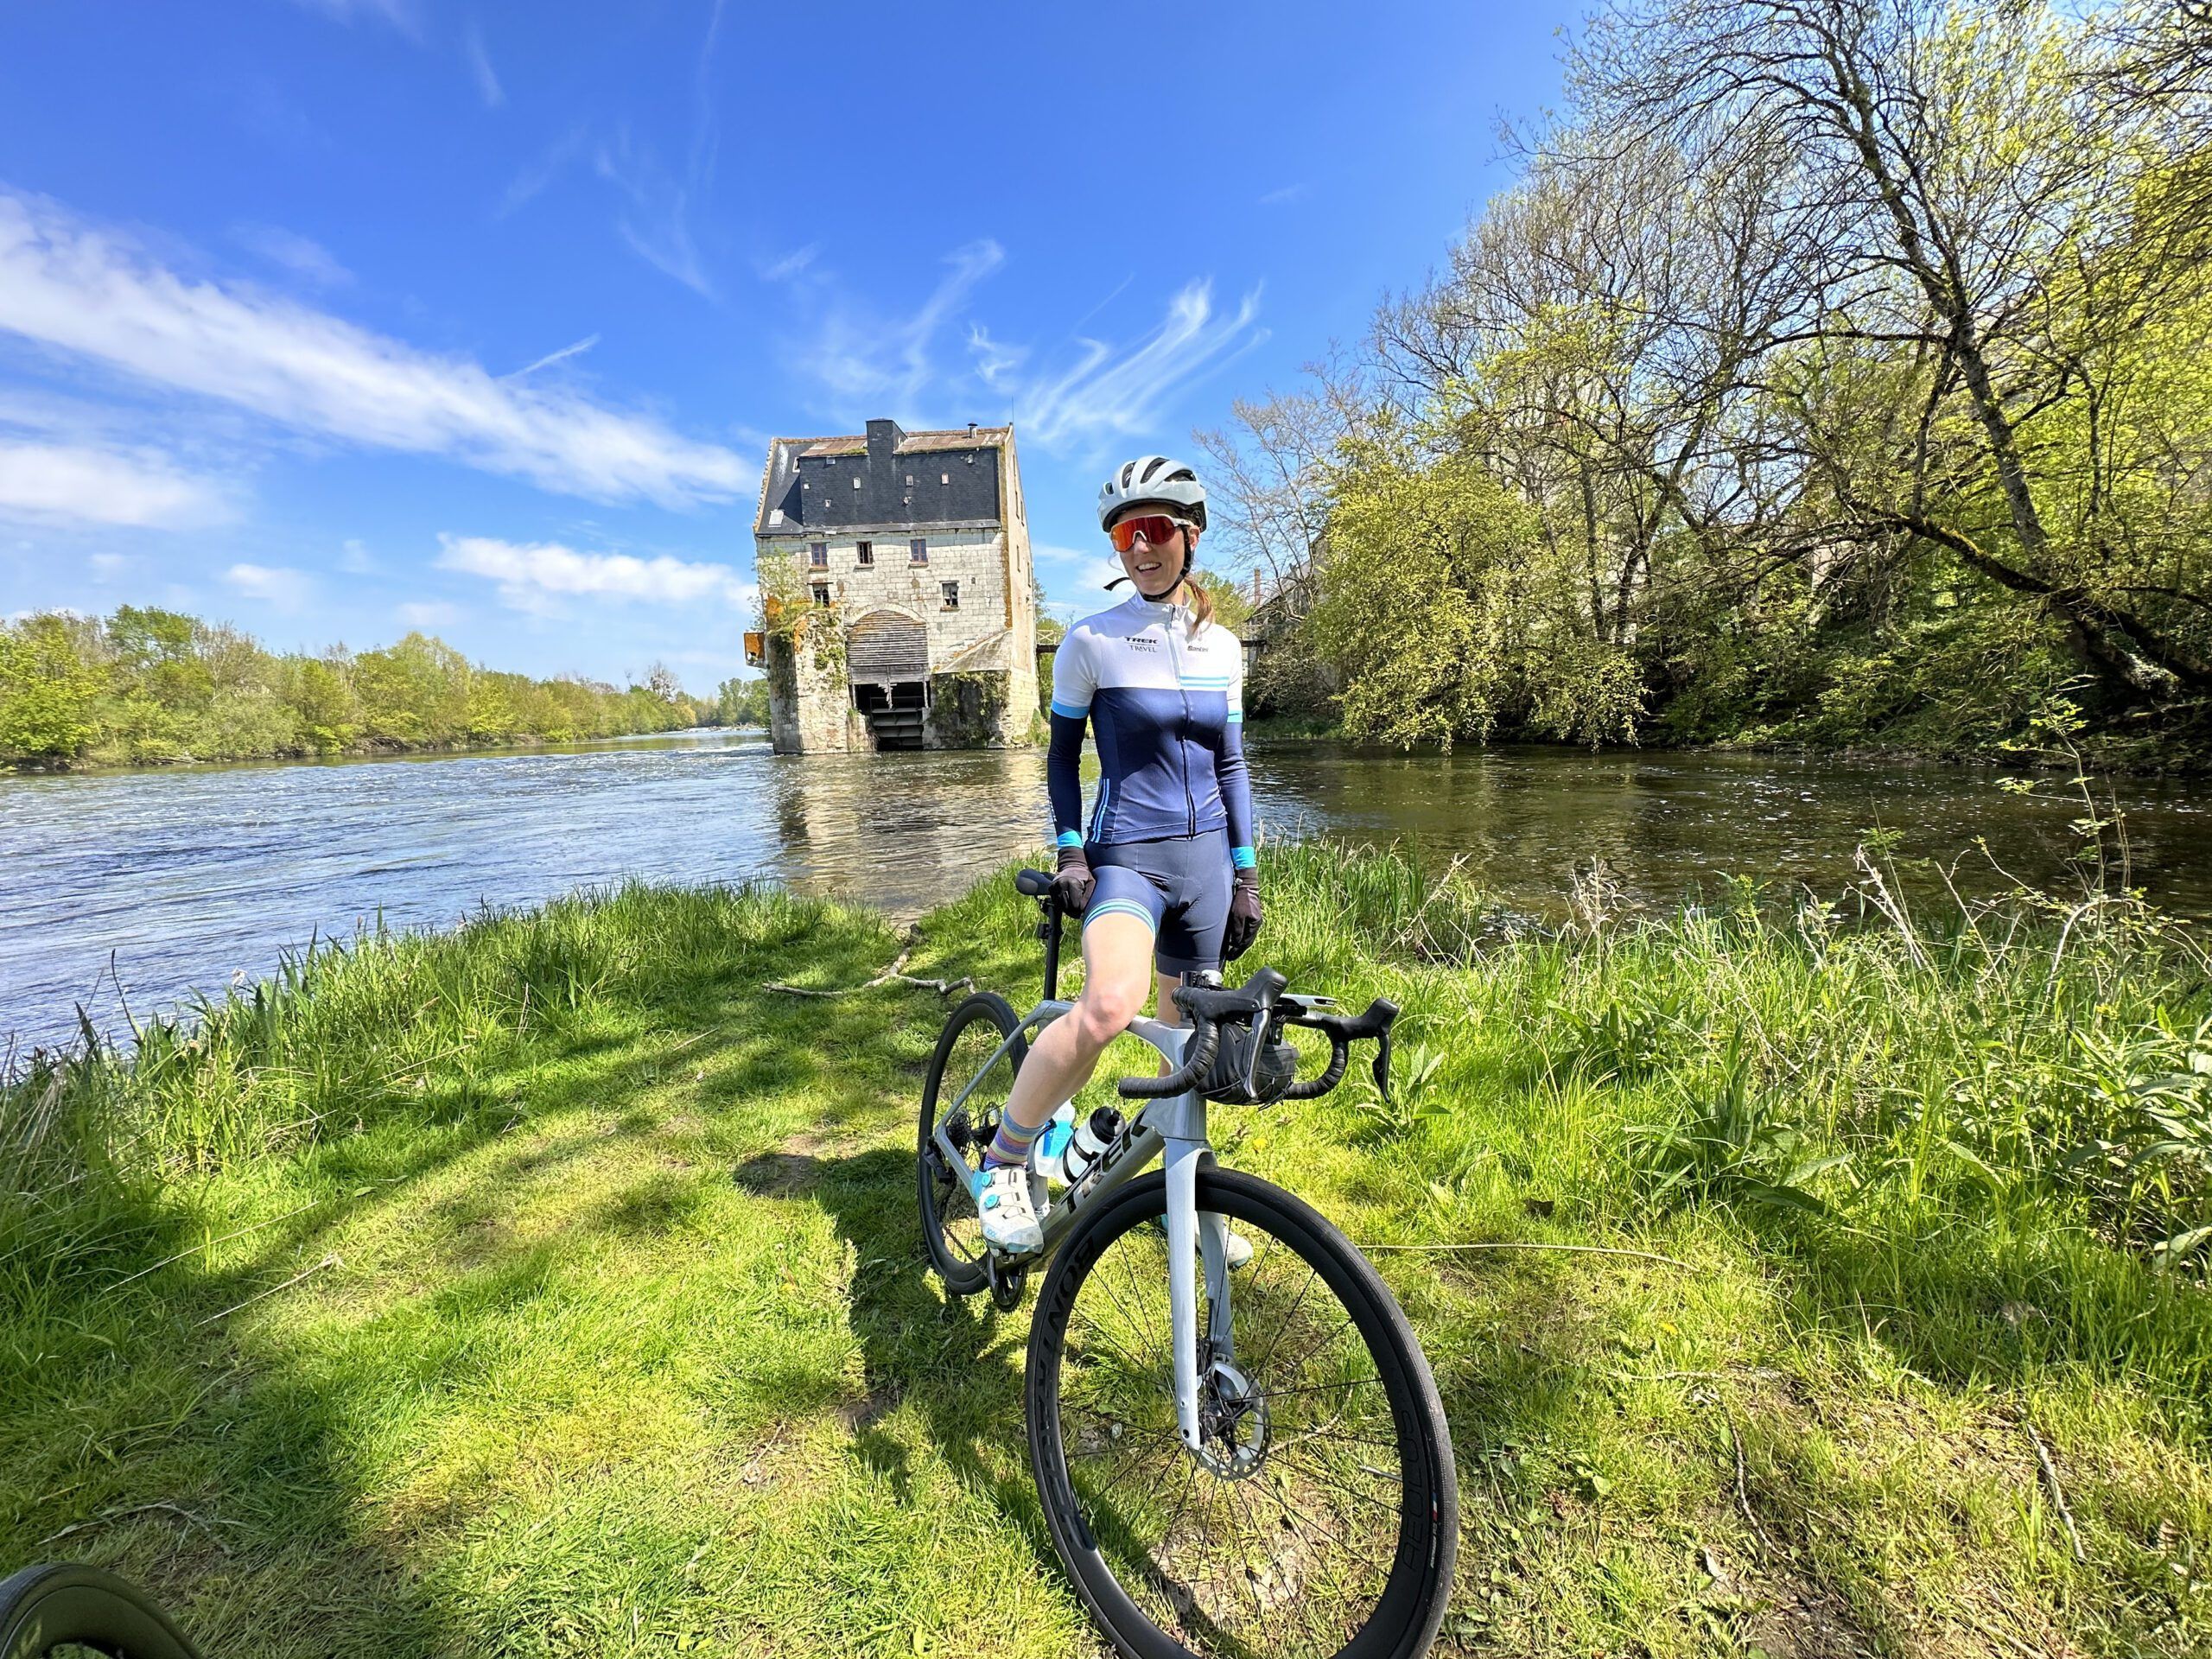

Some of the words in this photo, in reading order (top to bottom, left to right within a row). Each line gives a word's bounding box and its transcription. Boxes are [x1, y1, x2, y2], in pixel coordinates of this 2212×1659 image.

[1124, 636, 1158, 645] TREK
[1129, 645, 1158, 653] TRAVEL
[1060, 1107, 1148, 1214] TREK
[1402, 1409, 1424, 1572] AEOLUS
